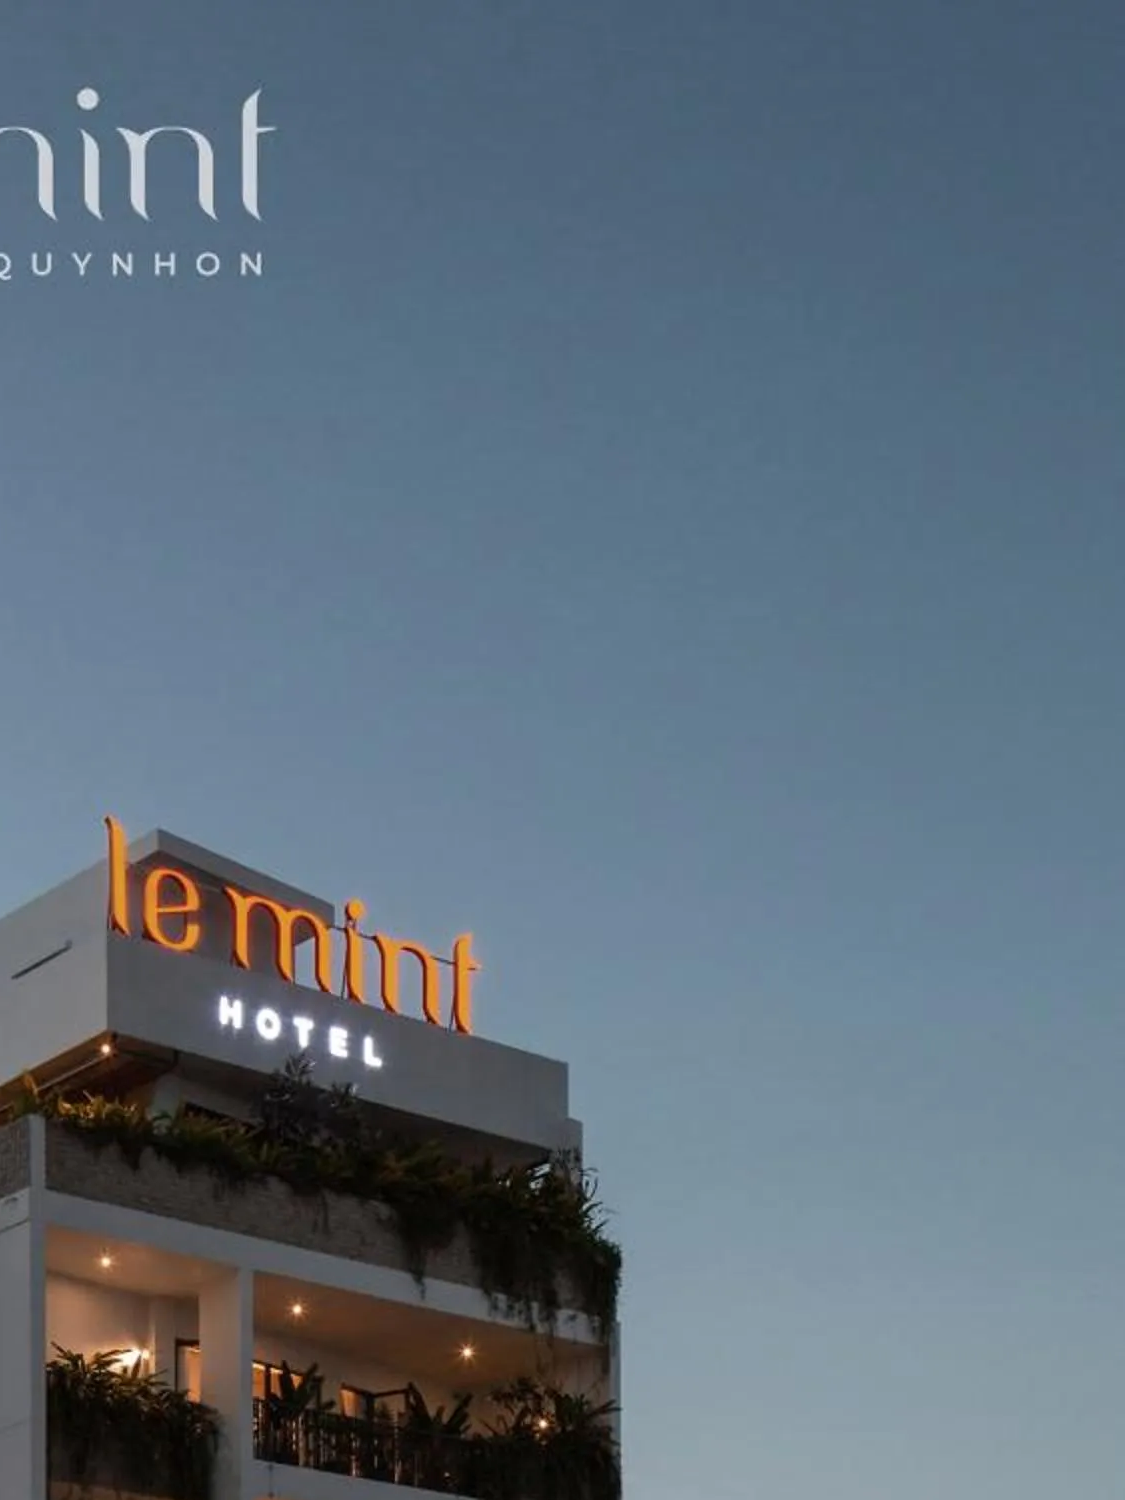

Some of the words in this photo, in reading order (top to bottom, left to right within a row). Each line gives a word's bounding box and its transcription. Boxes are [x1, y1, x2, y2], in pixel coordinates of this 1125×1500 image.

[104, 814, 201, 952] le
[223, 885, 480, 1034] mint
[217, 995, 383, 1068] HOTEL
